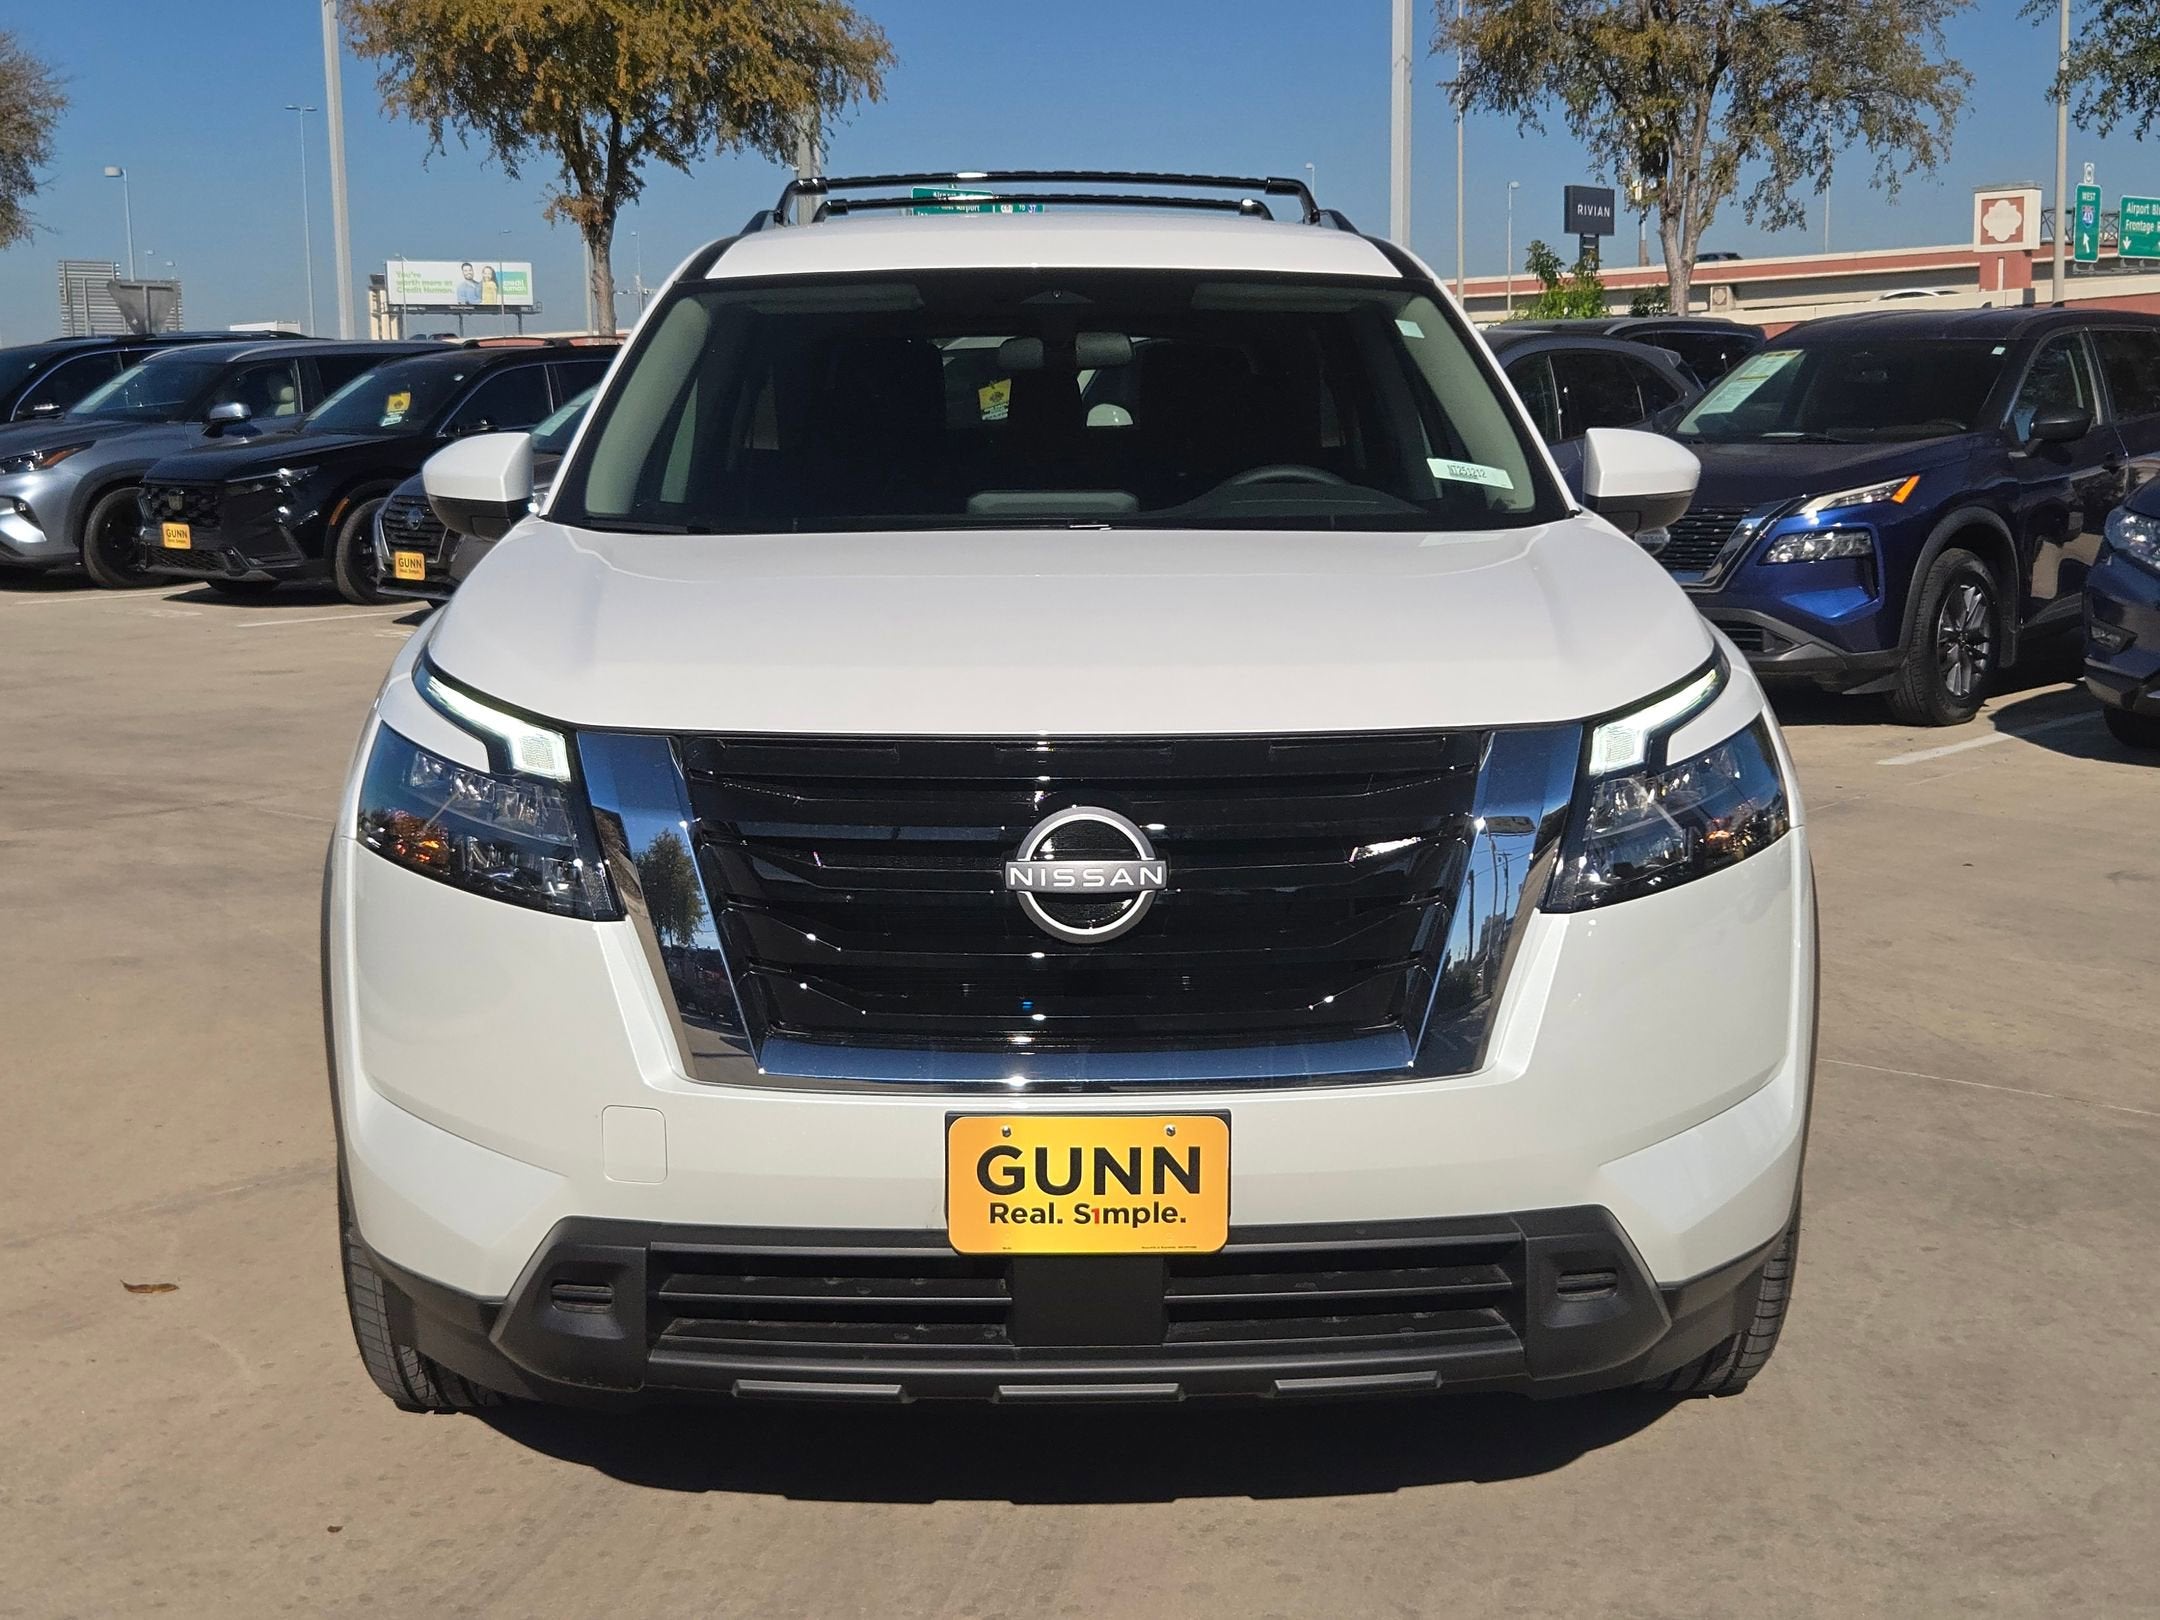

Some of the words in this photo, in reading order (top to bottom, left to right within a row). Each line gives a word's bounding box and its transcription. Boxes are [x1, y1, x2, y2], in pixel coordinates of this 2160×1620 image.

[2082, 192, 2096, 201] WEST
[1577, 204, 1610, 217] RIVIAN
[2126, 202, 2150, 216] Airport
[2125, 219, 2154, 234] Frontage
[166, 529, 187, 539] GUNN
[398, 557, 422, 569] GUNN
[1009, 866, 1163, 887] NISSAN
[976, 1145, 1201, 1196] GUNN
[989, 1201, 1063, 1225] Real.
